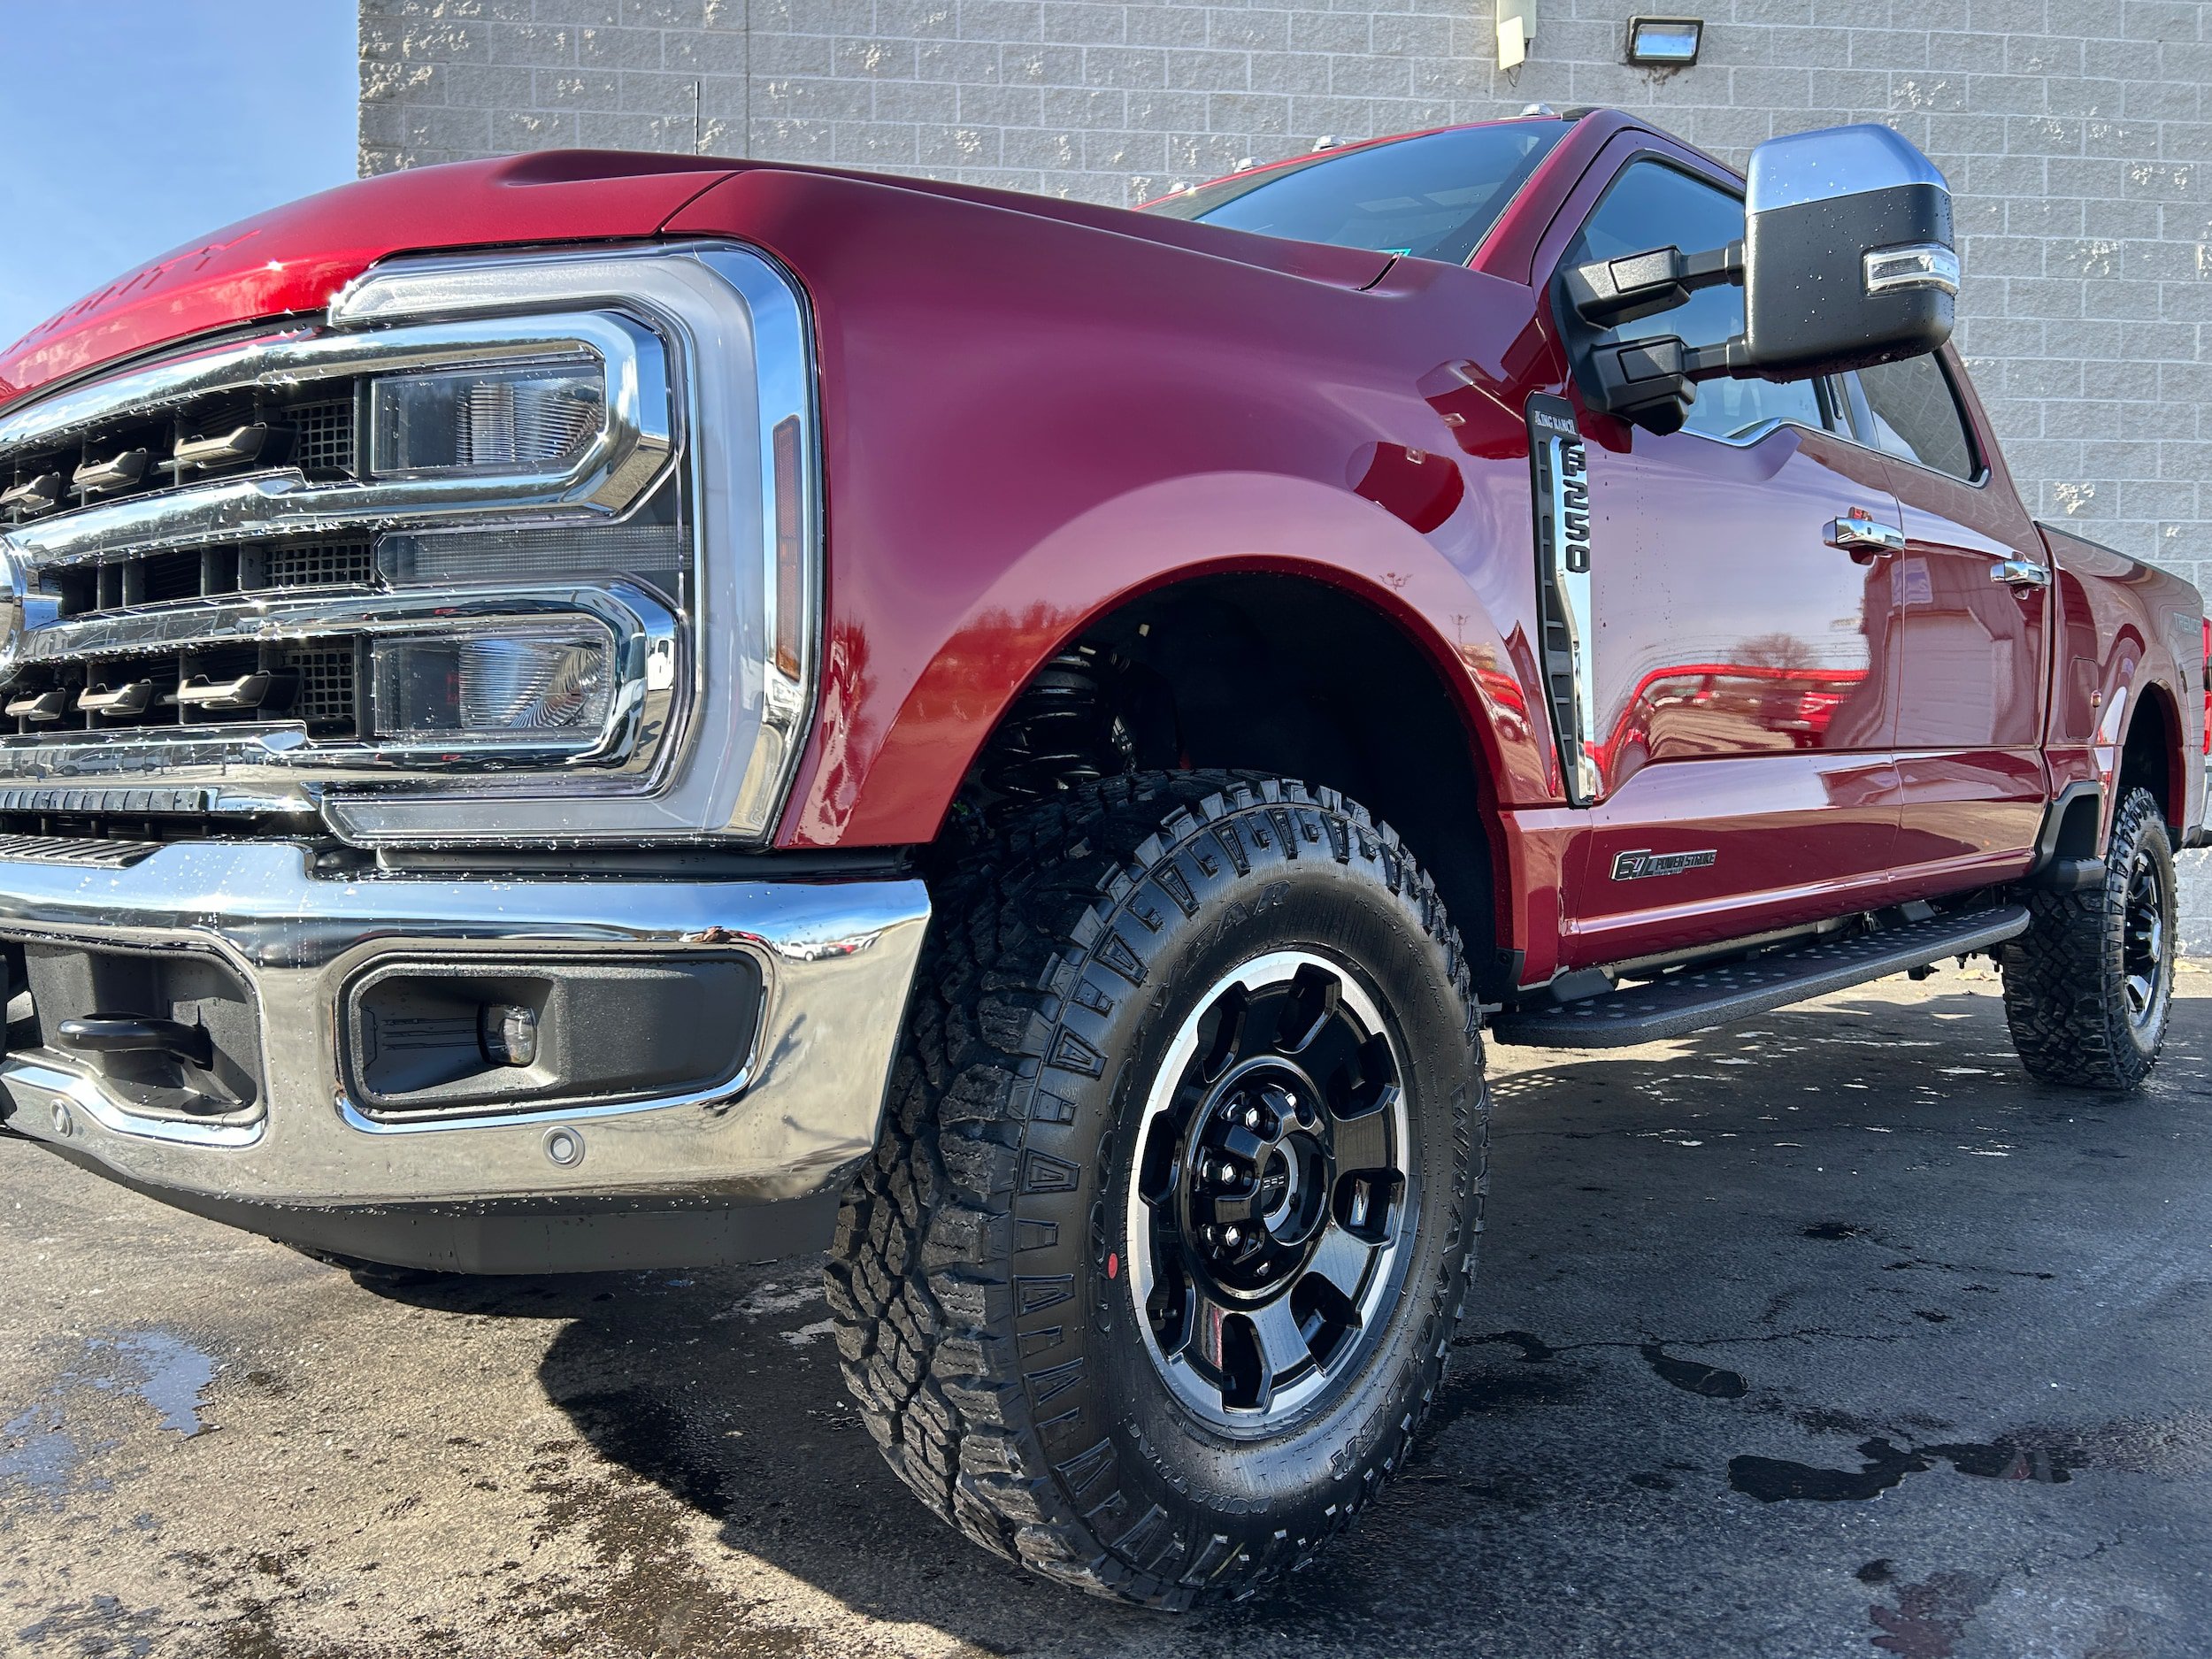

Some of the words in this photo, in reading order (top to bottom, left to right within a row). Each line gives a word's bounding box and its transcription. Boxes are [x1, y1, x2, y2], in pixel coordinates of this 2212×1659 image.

[1533, 411, 1553, 429] KING
[1553, 416, 1577, 435] RANCH
[1331, 1081, 1470, 1481] WRANGLER
[1124, 1413, 1272, 1515] DURATRAC
